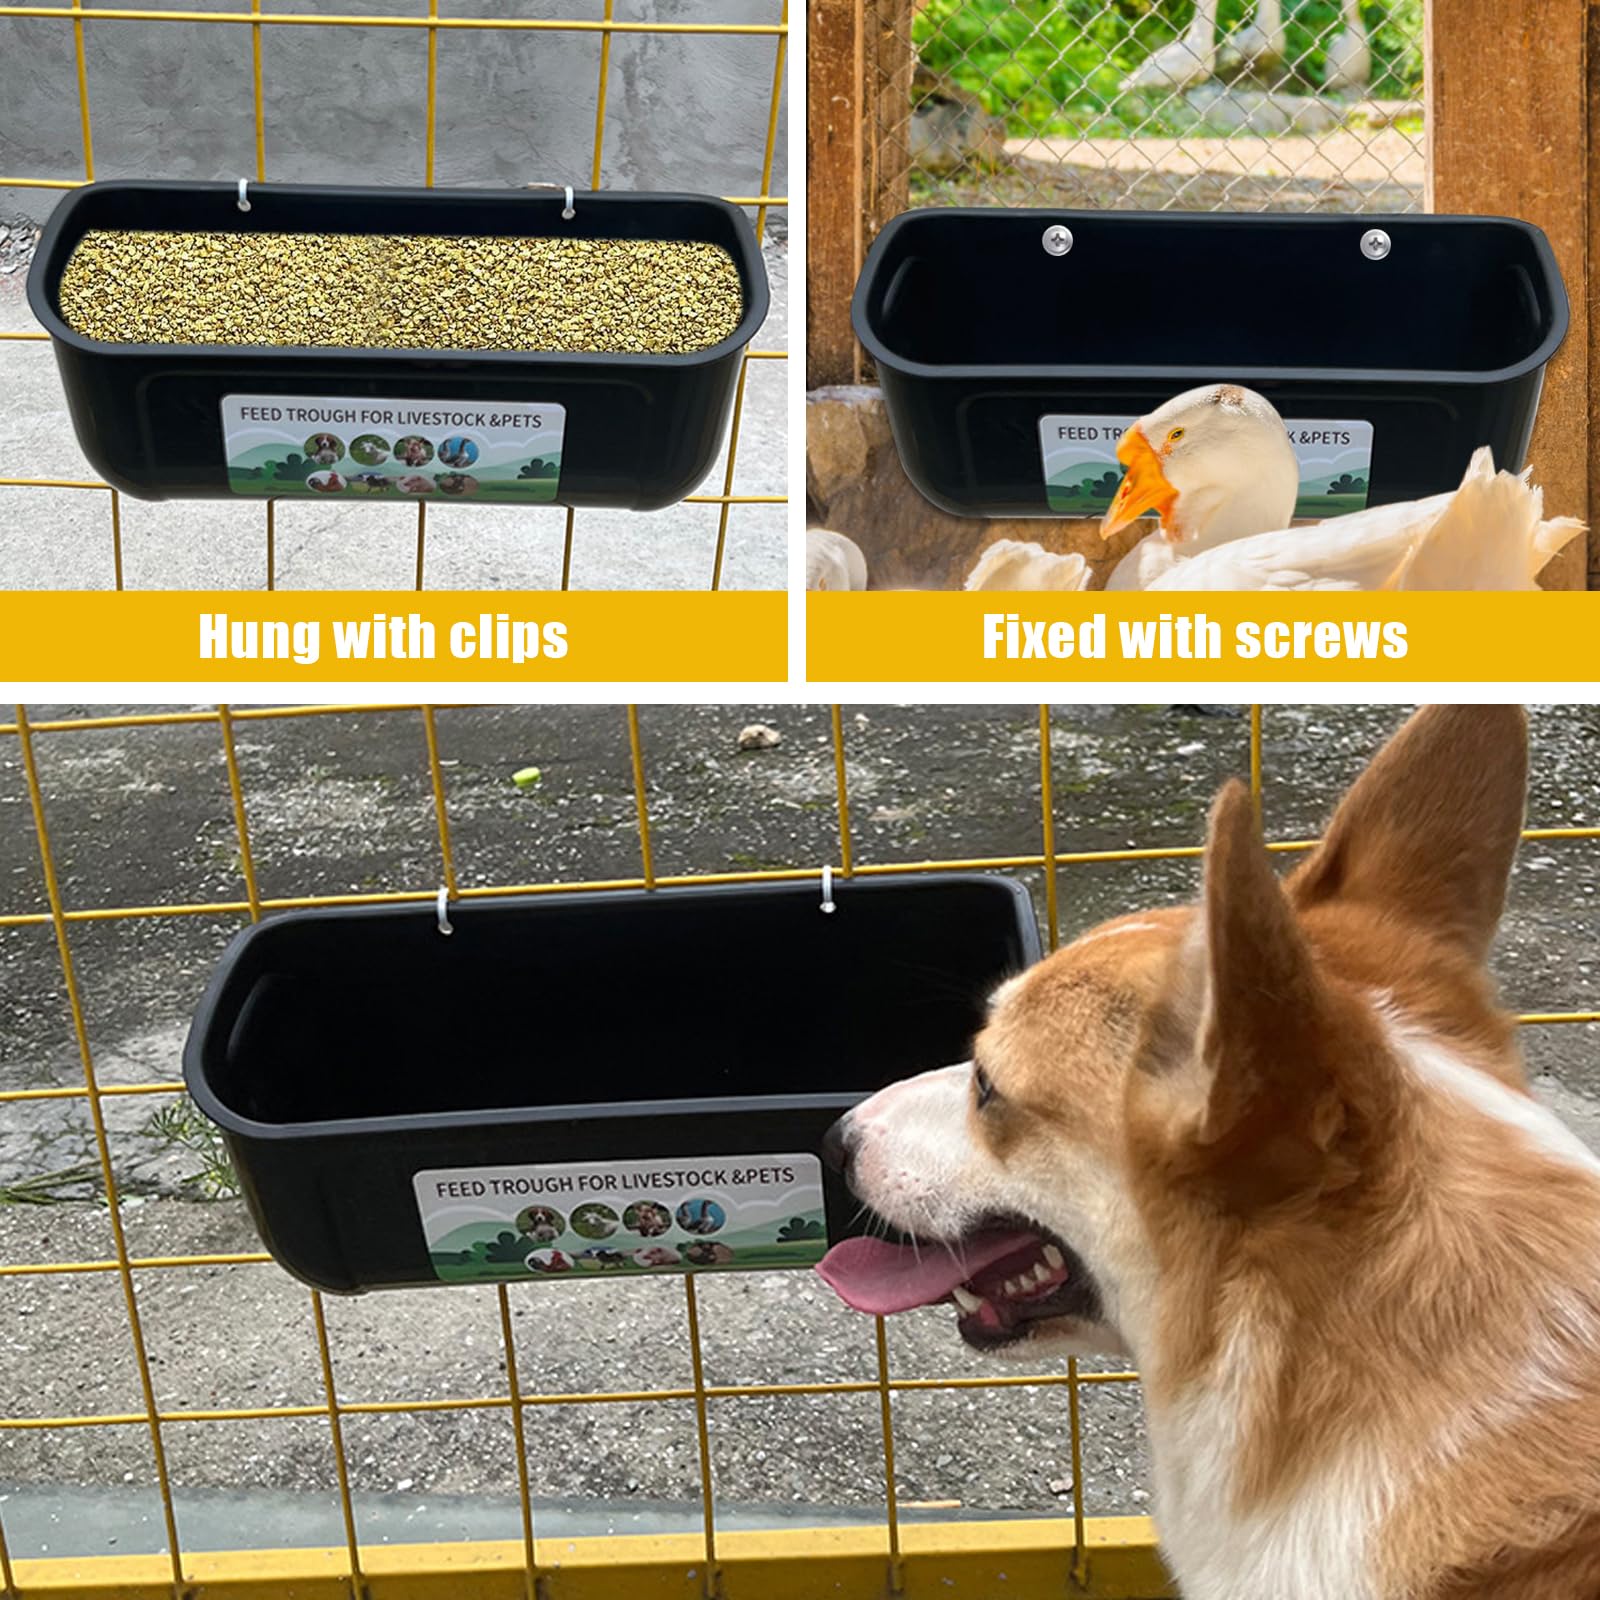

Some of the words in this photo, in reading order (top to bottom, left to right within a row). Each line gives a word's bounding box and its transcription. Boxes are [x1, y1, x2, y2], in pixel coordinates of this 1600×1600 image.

[240, 406, 282, 421] FEED
[286, 408, 356, 424] TROUGH
[361, 410, 393, 424] FOR
[397, 411, 486, 427] LIVESTOCK
[489, 413, 542, 429] &PETS
[1058, 426, 1099, 441] FEED
[1299, 430, 1351, 445] &PETS
[436, 1182, 486, 1198] FEED
[489, 1176, 573, 1194] TROUGH
[578, 1174, 617, 1192] FOR
[622, 1169, 728, 1190] LIVESTOCK
[731, 1166, 795, 1185] &PETS
